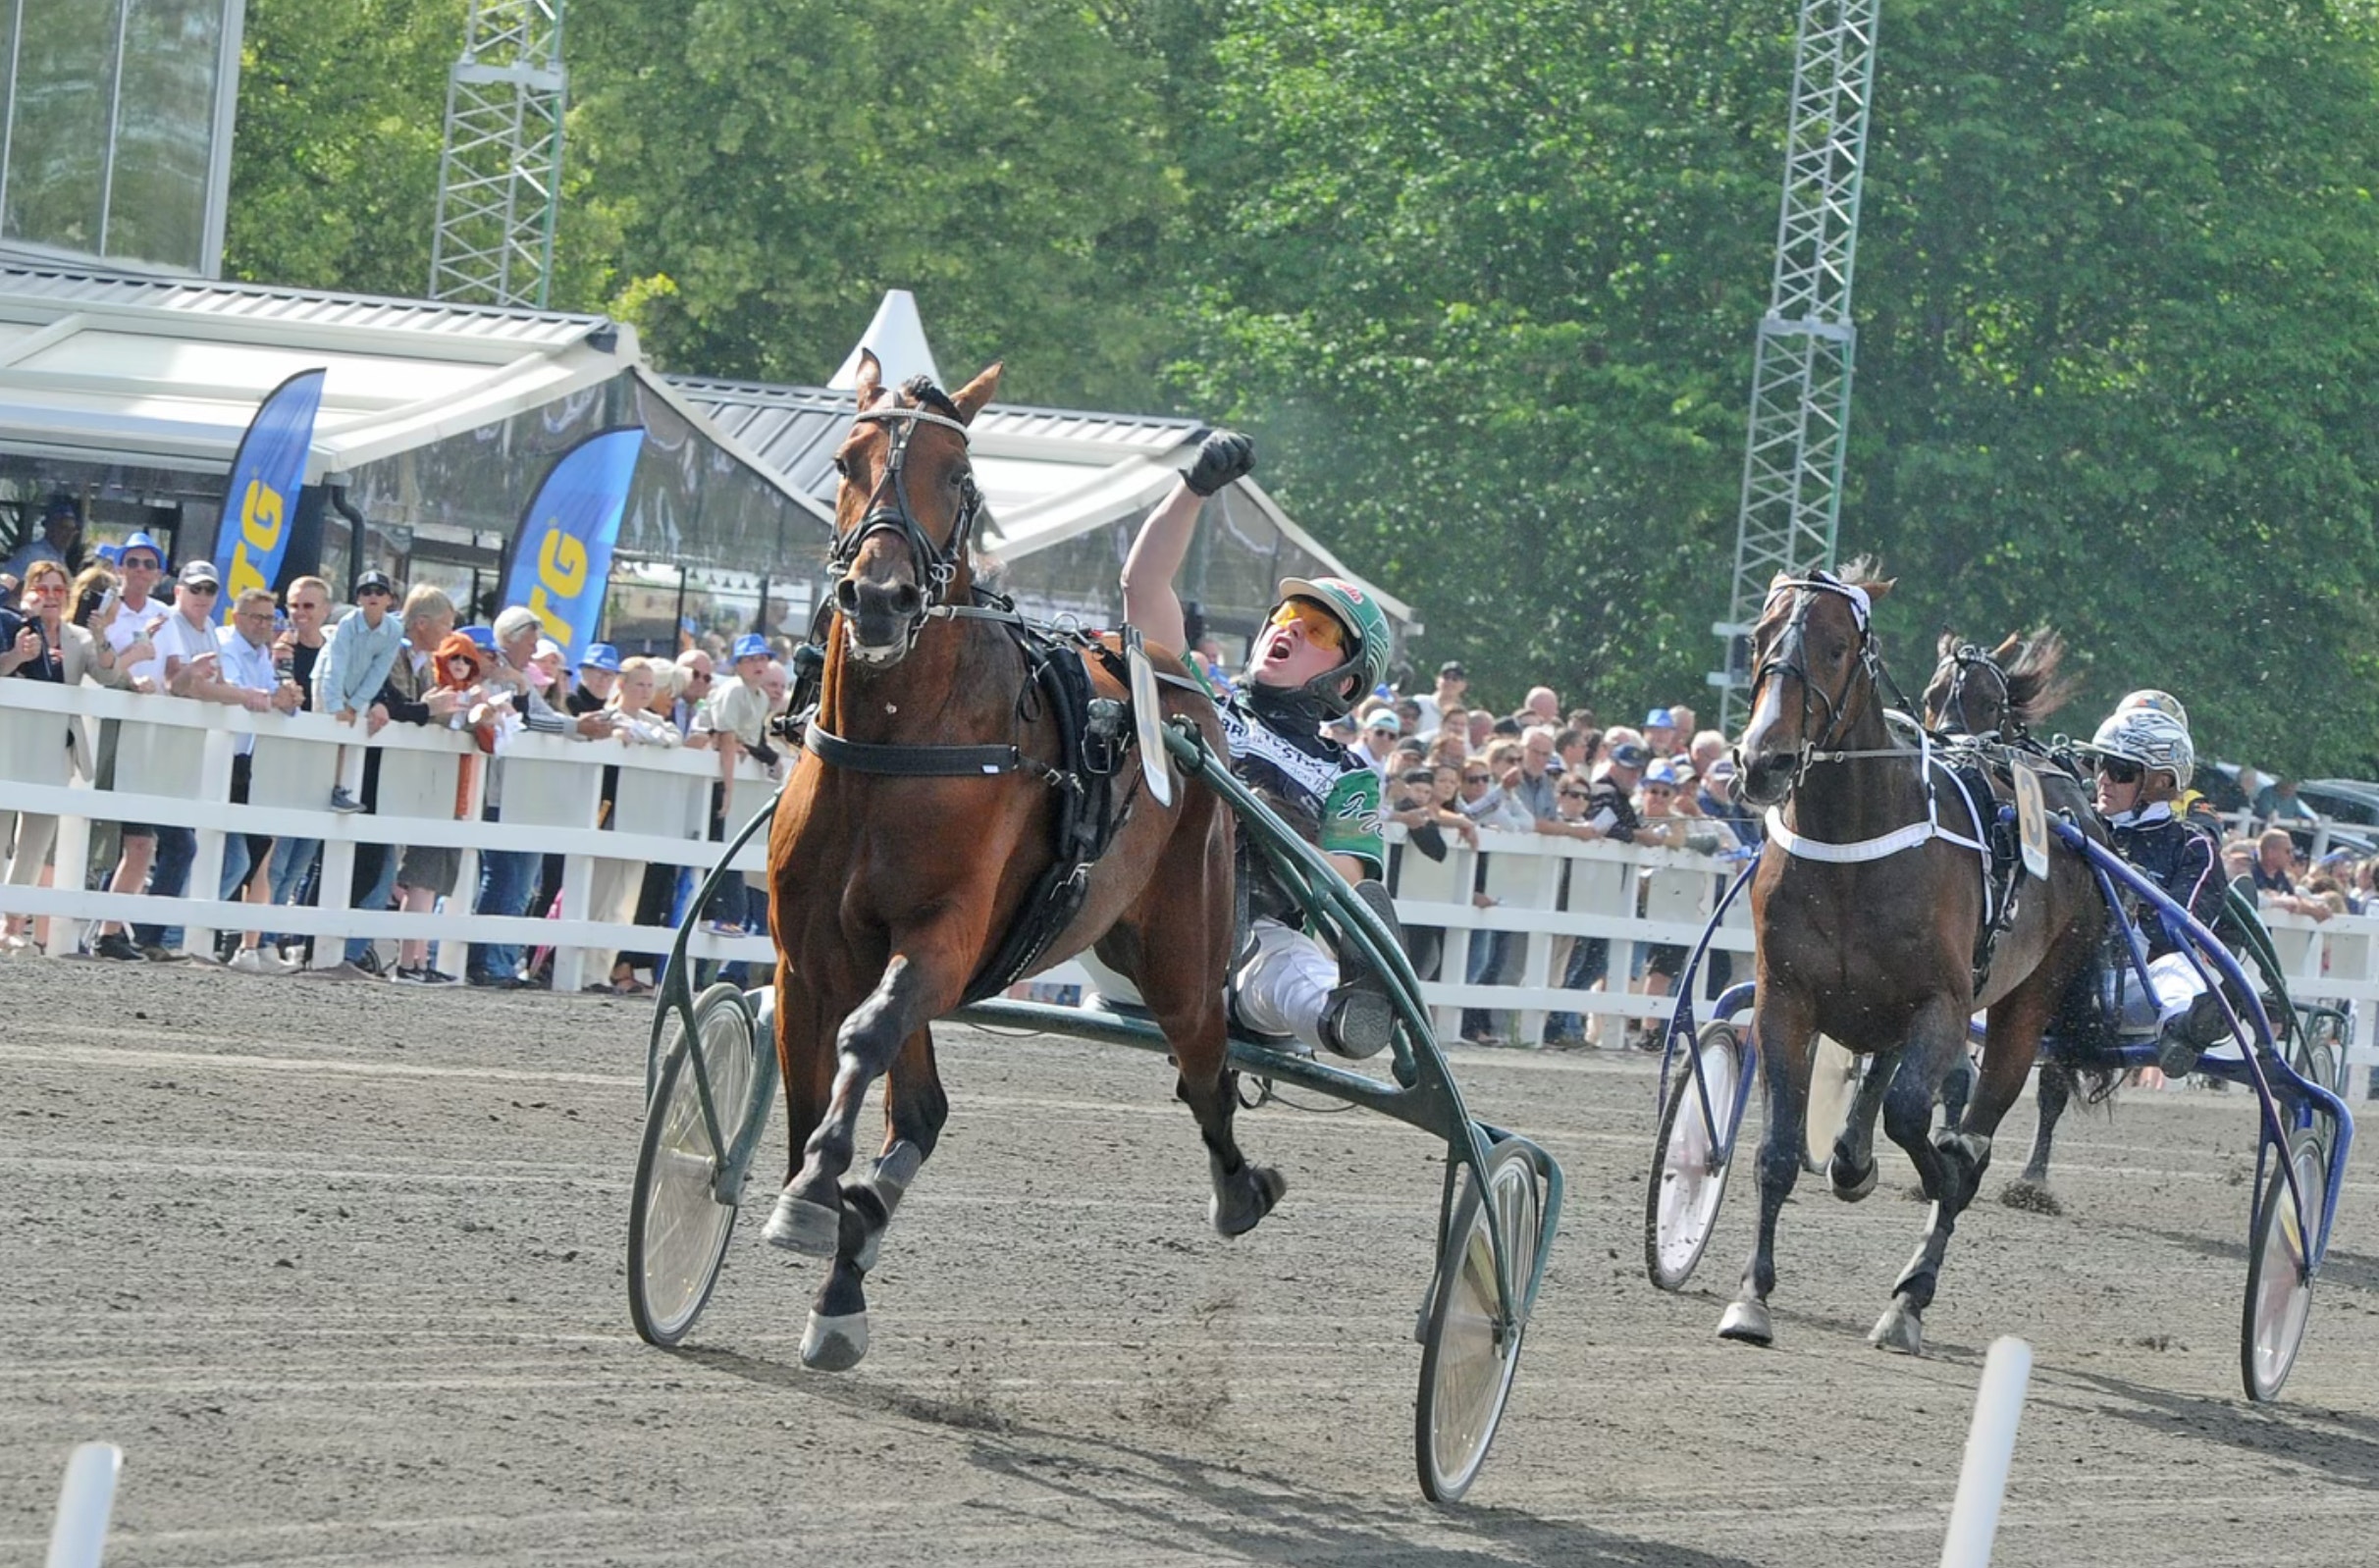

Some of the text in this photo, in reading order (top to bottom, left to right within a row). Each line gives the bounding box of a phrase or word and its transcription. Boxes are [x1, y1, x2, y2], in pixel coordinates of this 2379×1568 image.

[224, 479, 284, 626] TG
[528, 528, 588, 648] TG
[2020, 768, 2042, 847] 3
